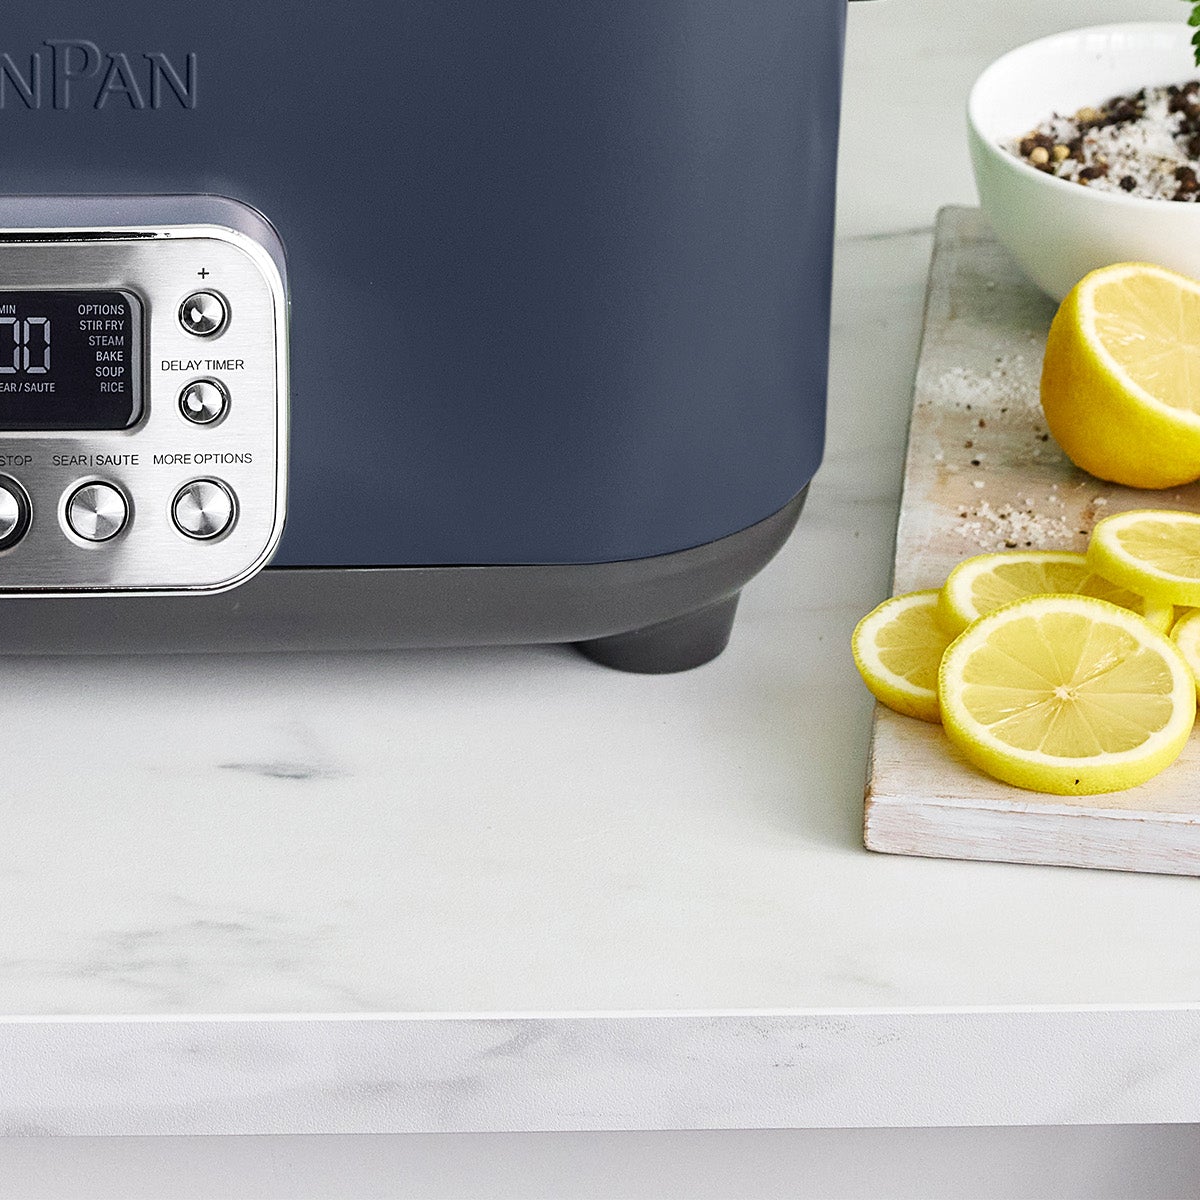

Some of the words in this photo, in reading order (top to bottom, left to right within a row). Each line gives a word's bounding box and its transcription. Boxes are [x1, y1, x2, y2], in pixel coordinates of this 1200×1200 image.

[78, 305, 124, 315] OPTIONS
[79, 320, 104, 331] STIR
[105, 320, 124, 331] FRY
[88, 336, 124, 346] STEAM
[96, 351, 123, 361] BAKE
[161, 359, 202, 371] DELAY
[204, 359, 245, 371] TIMER
[95, 367, 124, 377] SOUP
[24, 382, 55, 392] SAUTE
[100, 382, 124, 392] RICE
[53, 454, 87, 466] SEAR
[95, 454, 139, 466] SAUTE
[153, 453, 191, 465] MORE
[194, 452, 253, 465] OPTIONS
